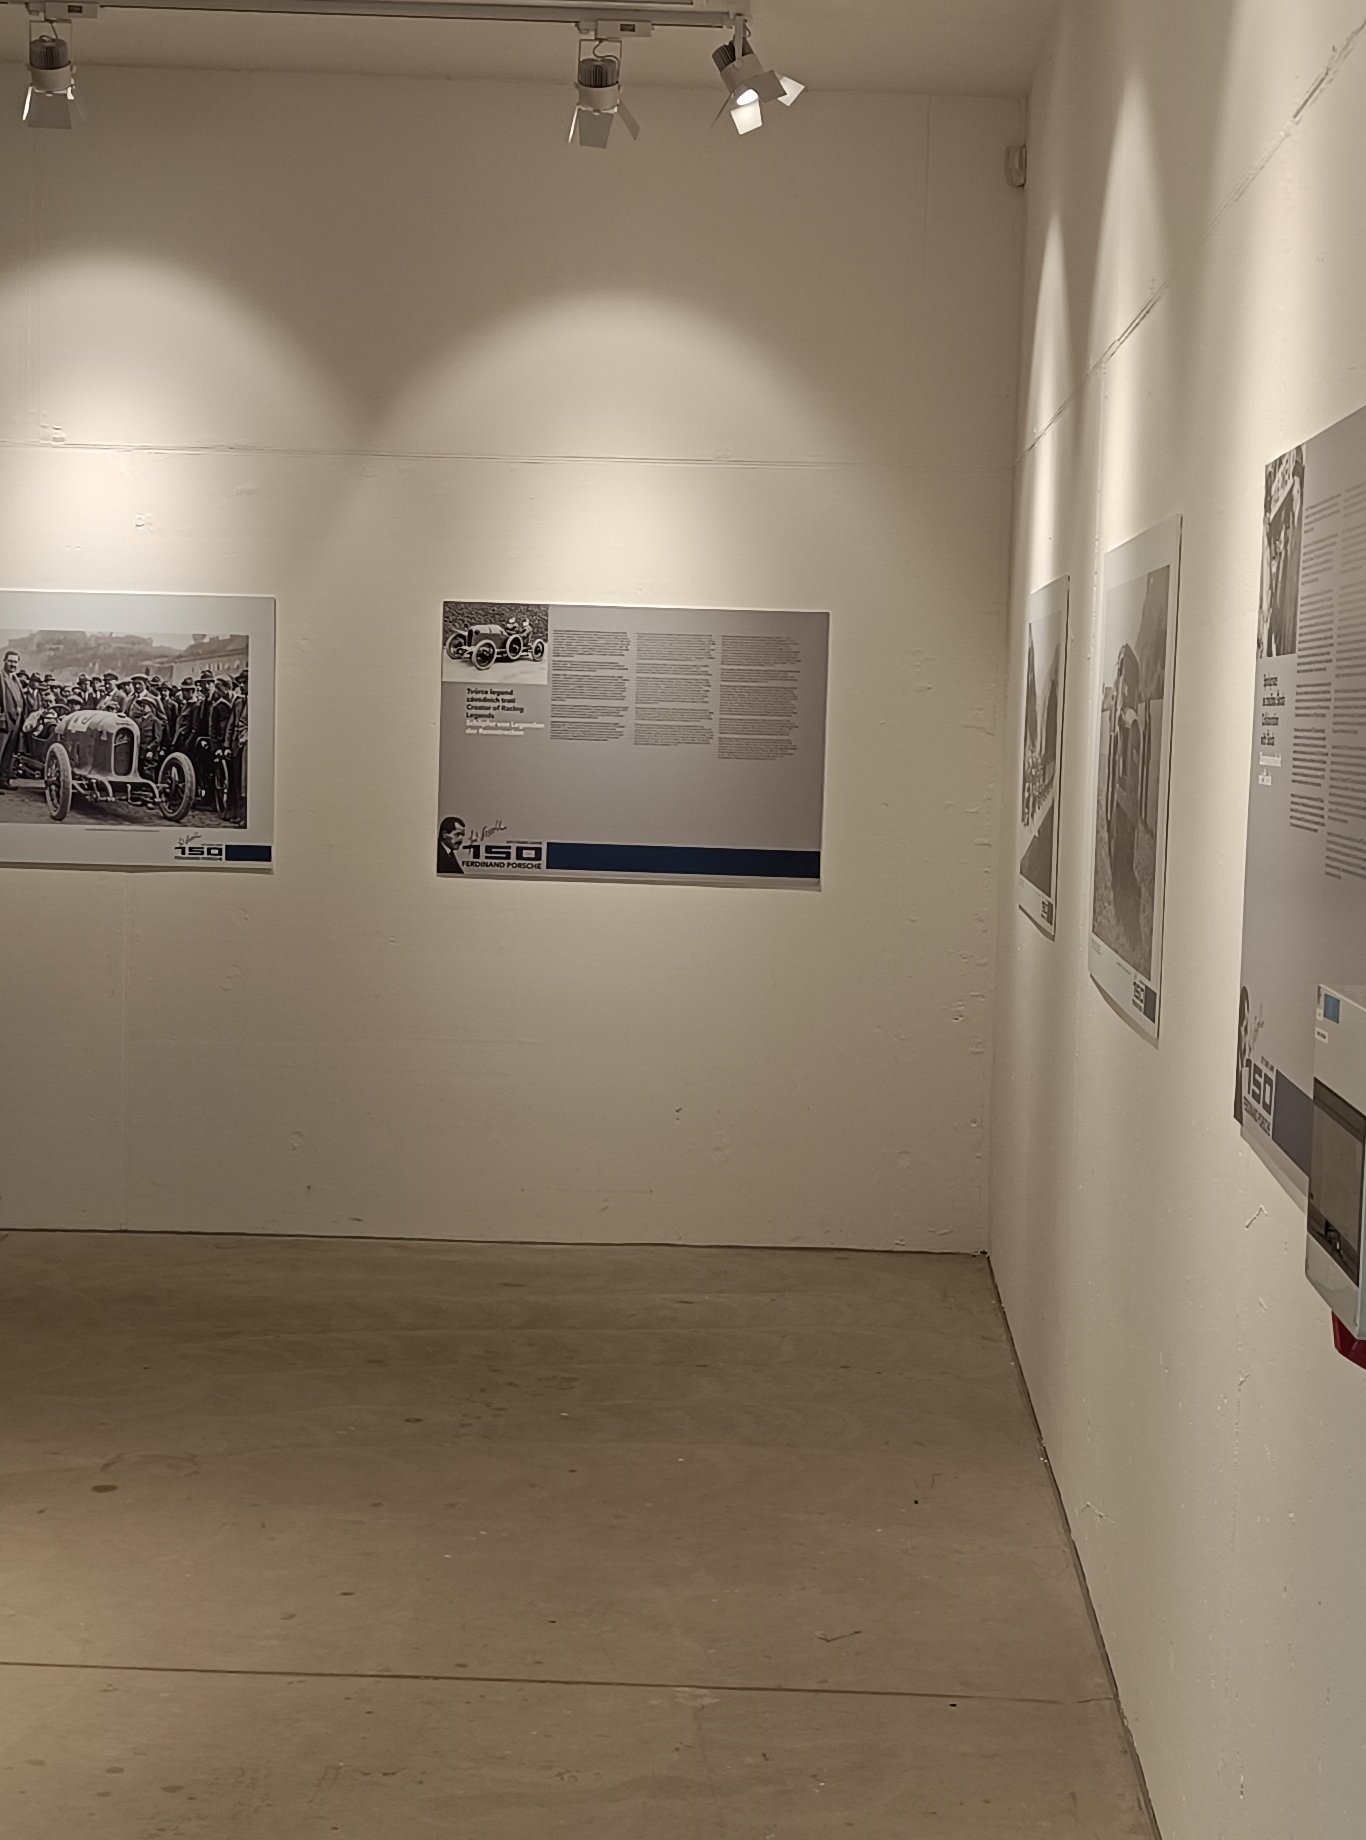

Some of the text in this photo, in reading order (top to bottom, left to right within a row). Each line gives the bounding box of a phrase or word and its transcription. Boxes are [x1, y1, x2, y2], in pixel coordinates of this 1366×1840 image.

[175, 847, 223, 856] 150
[462, 845, 542, 861] 150
[1245, 1058, 1273, 1116] 150
